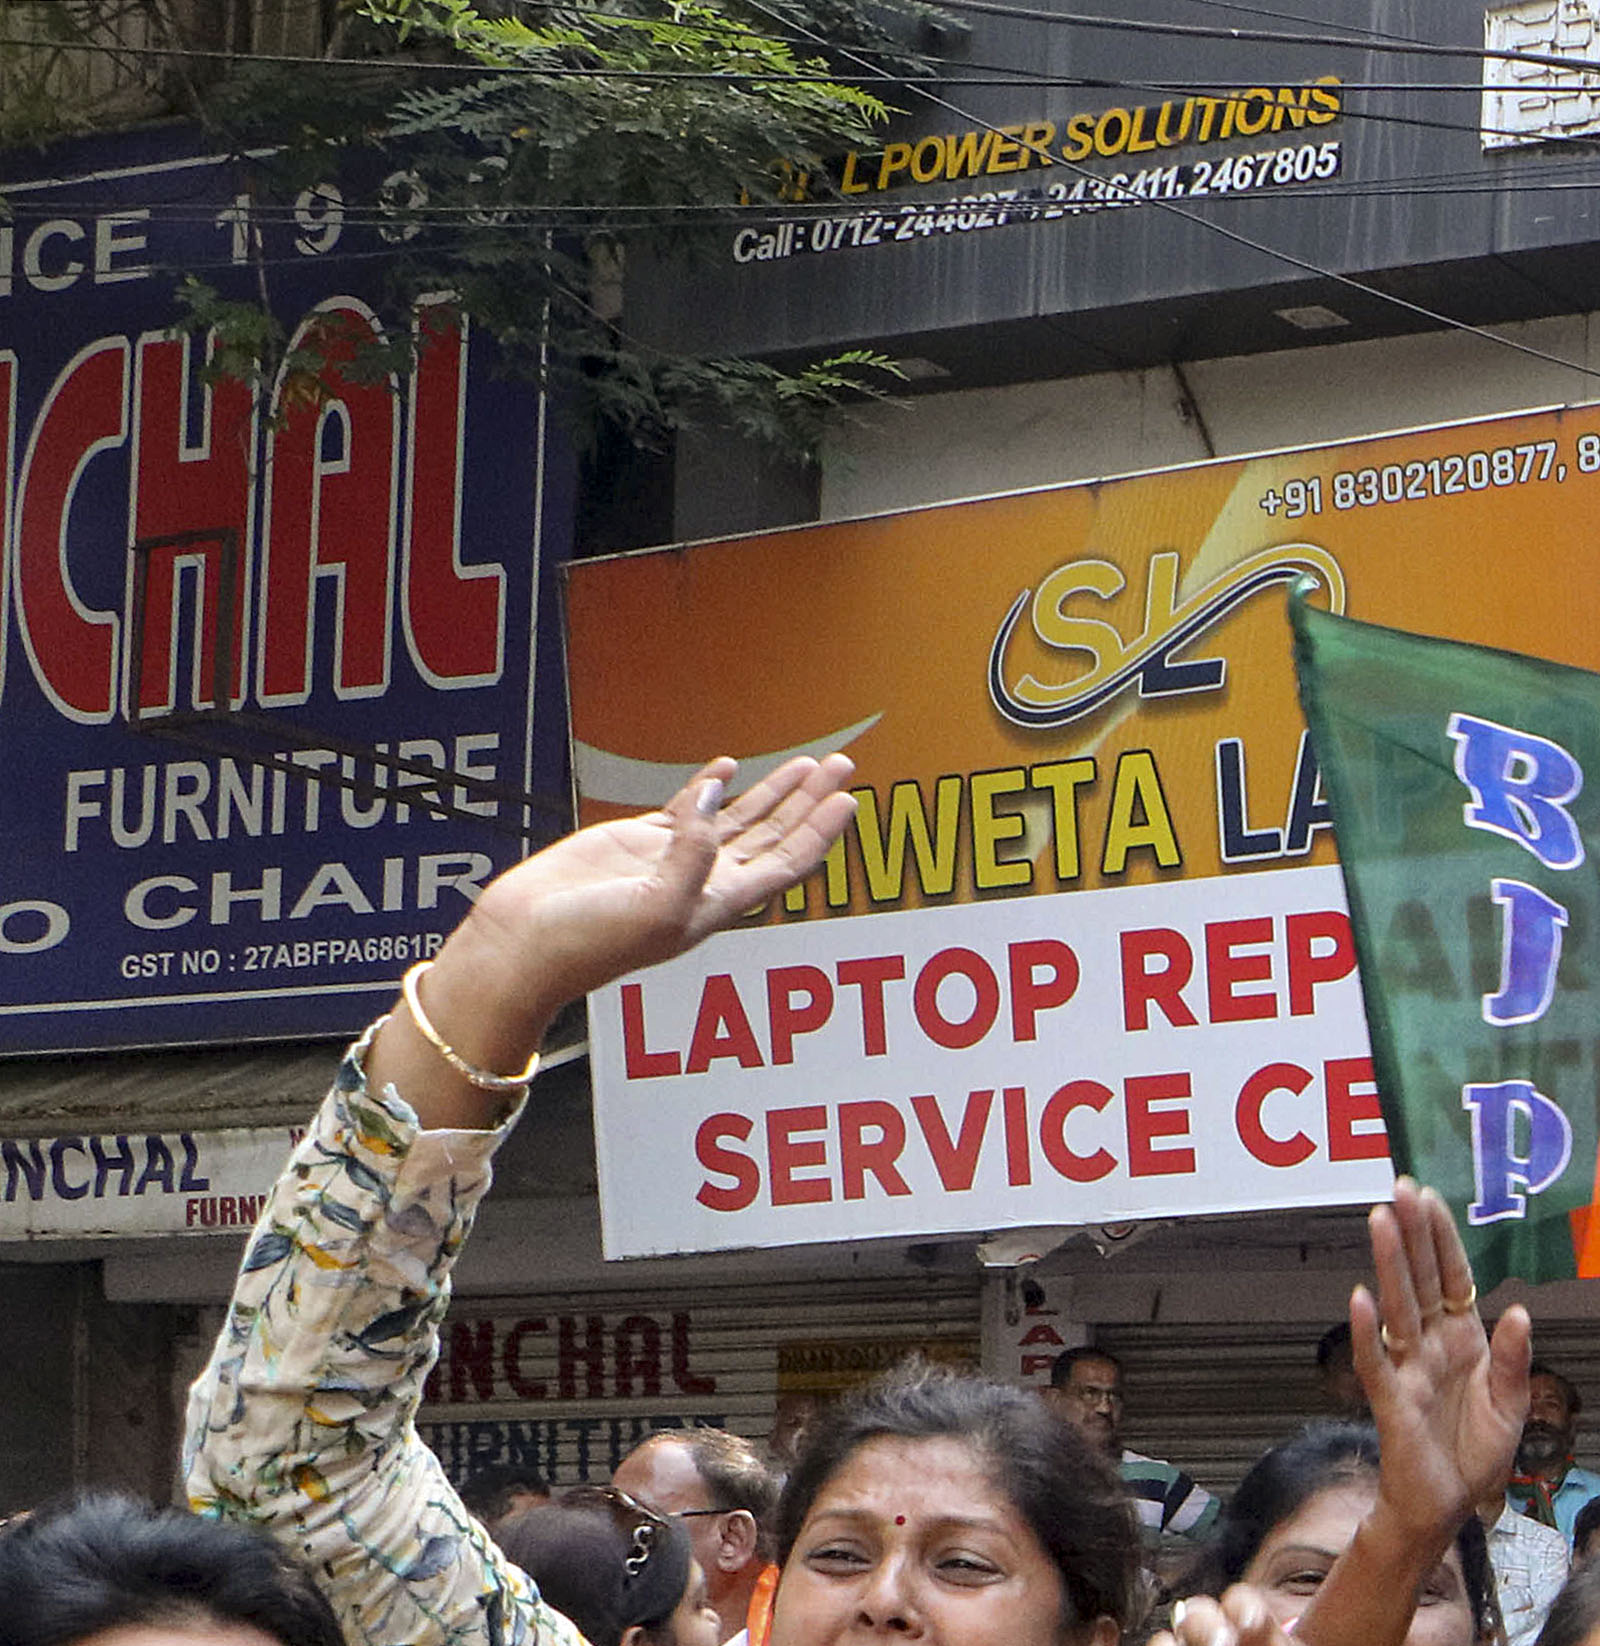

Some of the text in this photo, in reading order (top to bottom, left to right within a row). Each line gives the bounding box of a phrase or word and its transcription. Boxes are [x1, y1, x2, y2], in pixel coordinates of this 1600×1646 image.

[877, 118, 1055, 192] POWER
[1066, 74, 1343, 162] SOLUTIONS
[733, 221, 805, 263] Call:
[0, 294, 508, 726] CHAL
[1259, 477, 1322, 518] +91
[1332, 440, 1567, 511] 8302120877,
[64, 733, 500, 853] FURNITURE
[1216, 728, 1336, 864] LA
[121, 955, 174, 980] GST
[180, 948, 220, 976] NO
[244, 931, 447, 972] 27ABFPA6861R
[621, 938, 1081, 1081] LAPTOP
[0, 1132, 211, 1201] NCHAL
[694, 1055, 1393, 1212] SERVICE CE
